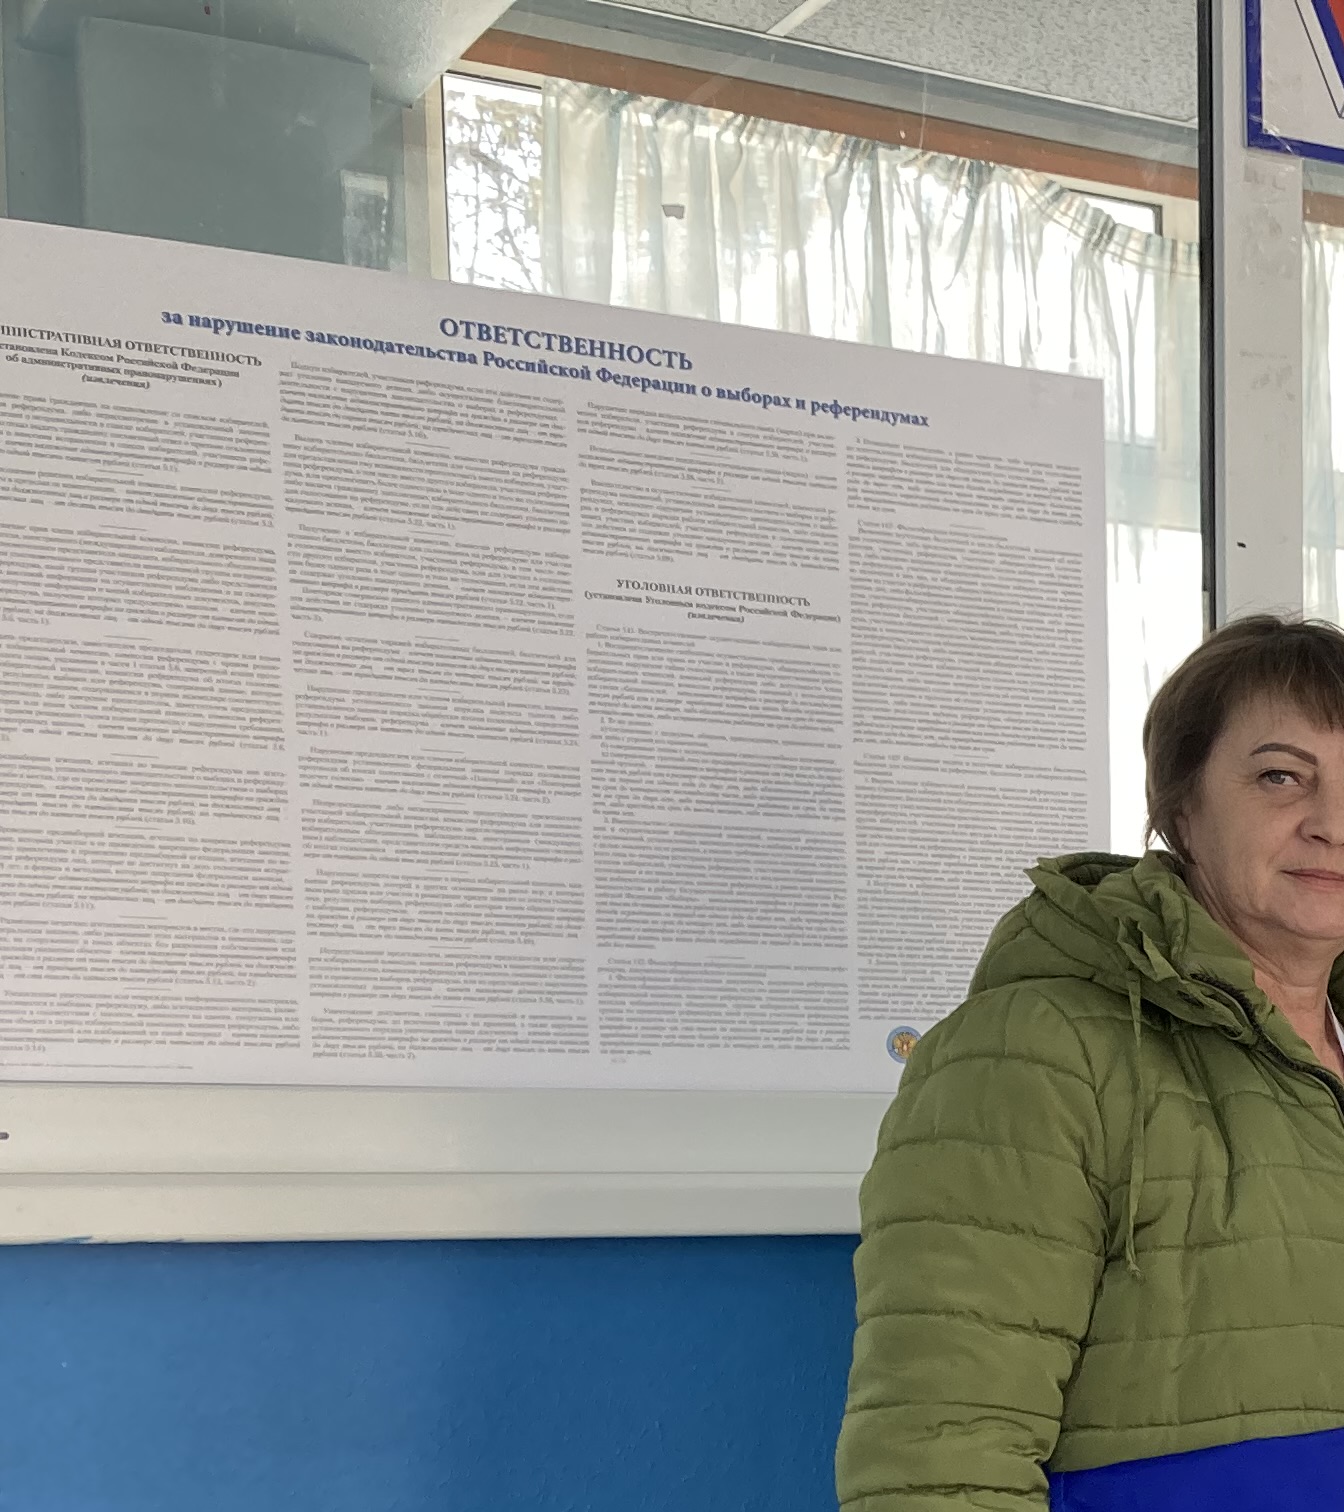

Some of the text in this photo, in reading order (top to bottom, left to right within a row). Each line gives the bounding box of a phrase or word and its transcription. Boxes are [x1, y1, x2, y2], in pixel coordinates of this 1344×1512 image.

[125, 340, 261, 367] ОТВЕТСТВЕННОСТЬ
[439, 317, 693, 370] ОТВЕТСТВЕННОСТЬ
[161, 309, 930, 428] за нарушение законодательства Российской Федерации о выборах и референдумах
[616, 579, 810, 607] УГОЛОВНАЯ ОТВЕТСТВЕННОСТЬ
